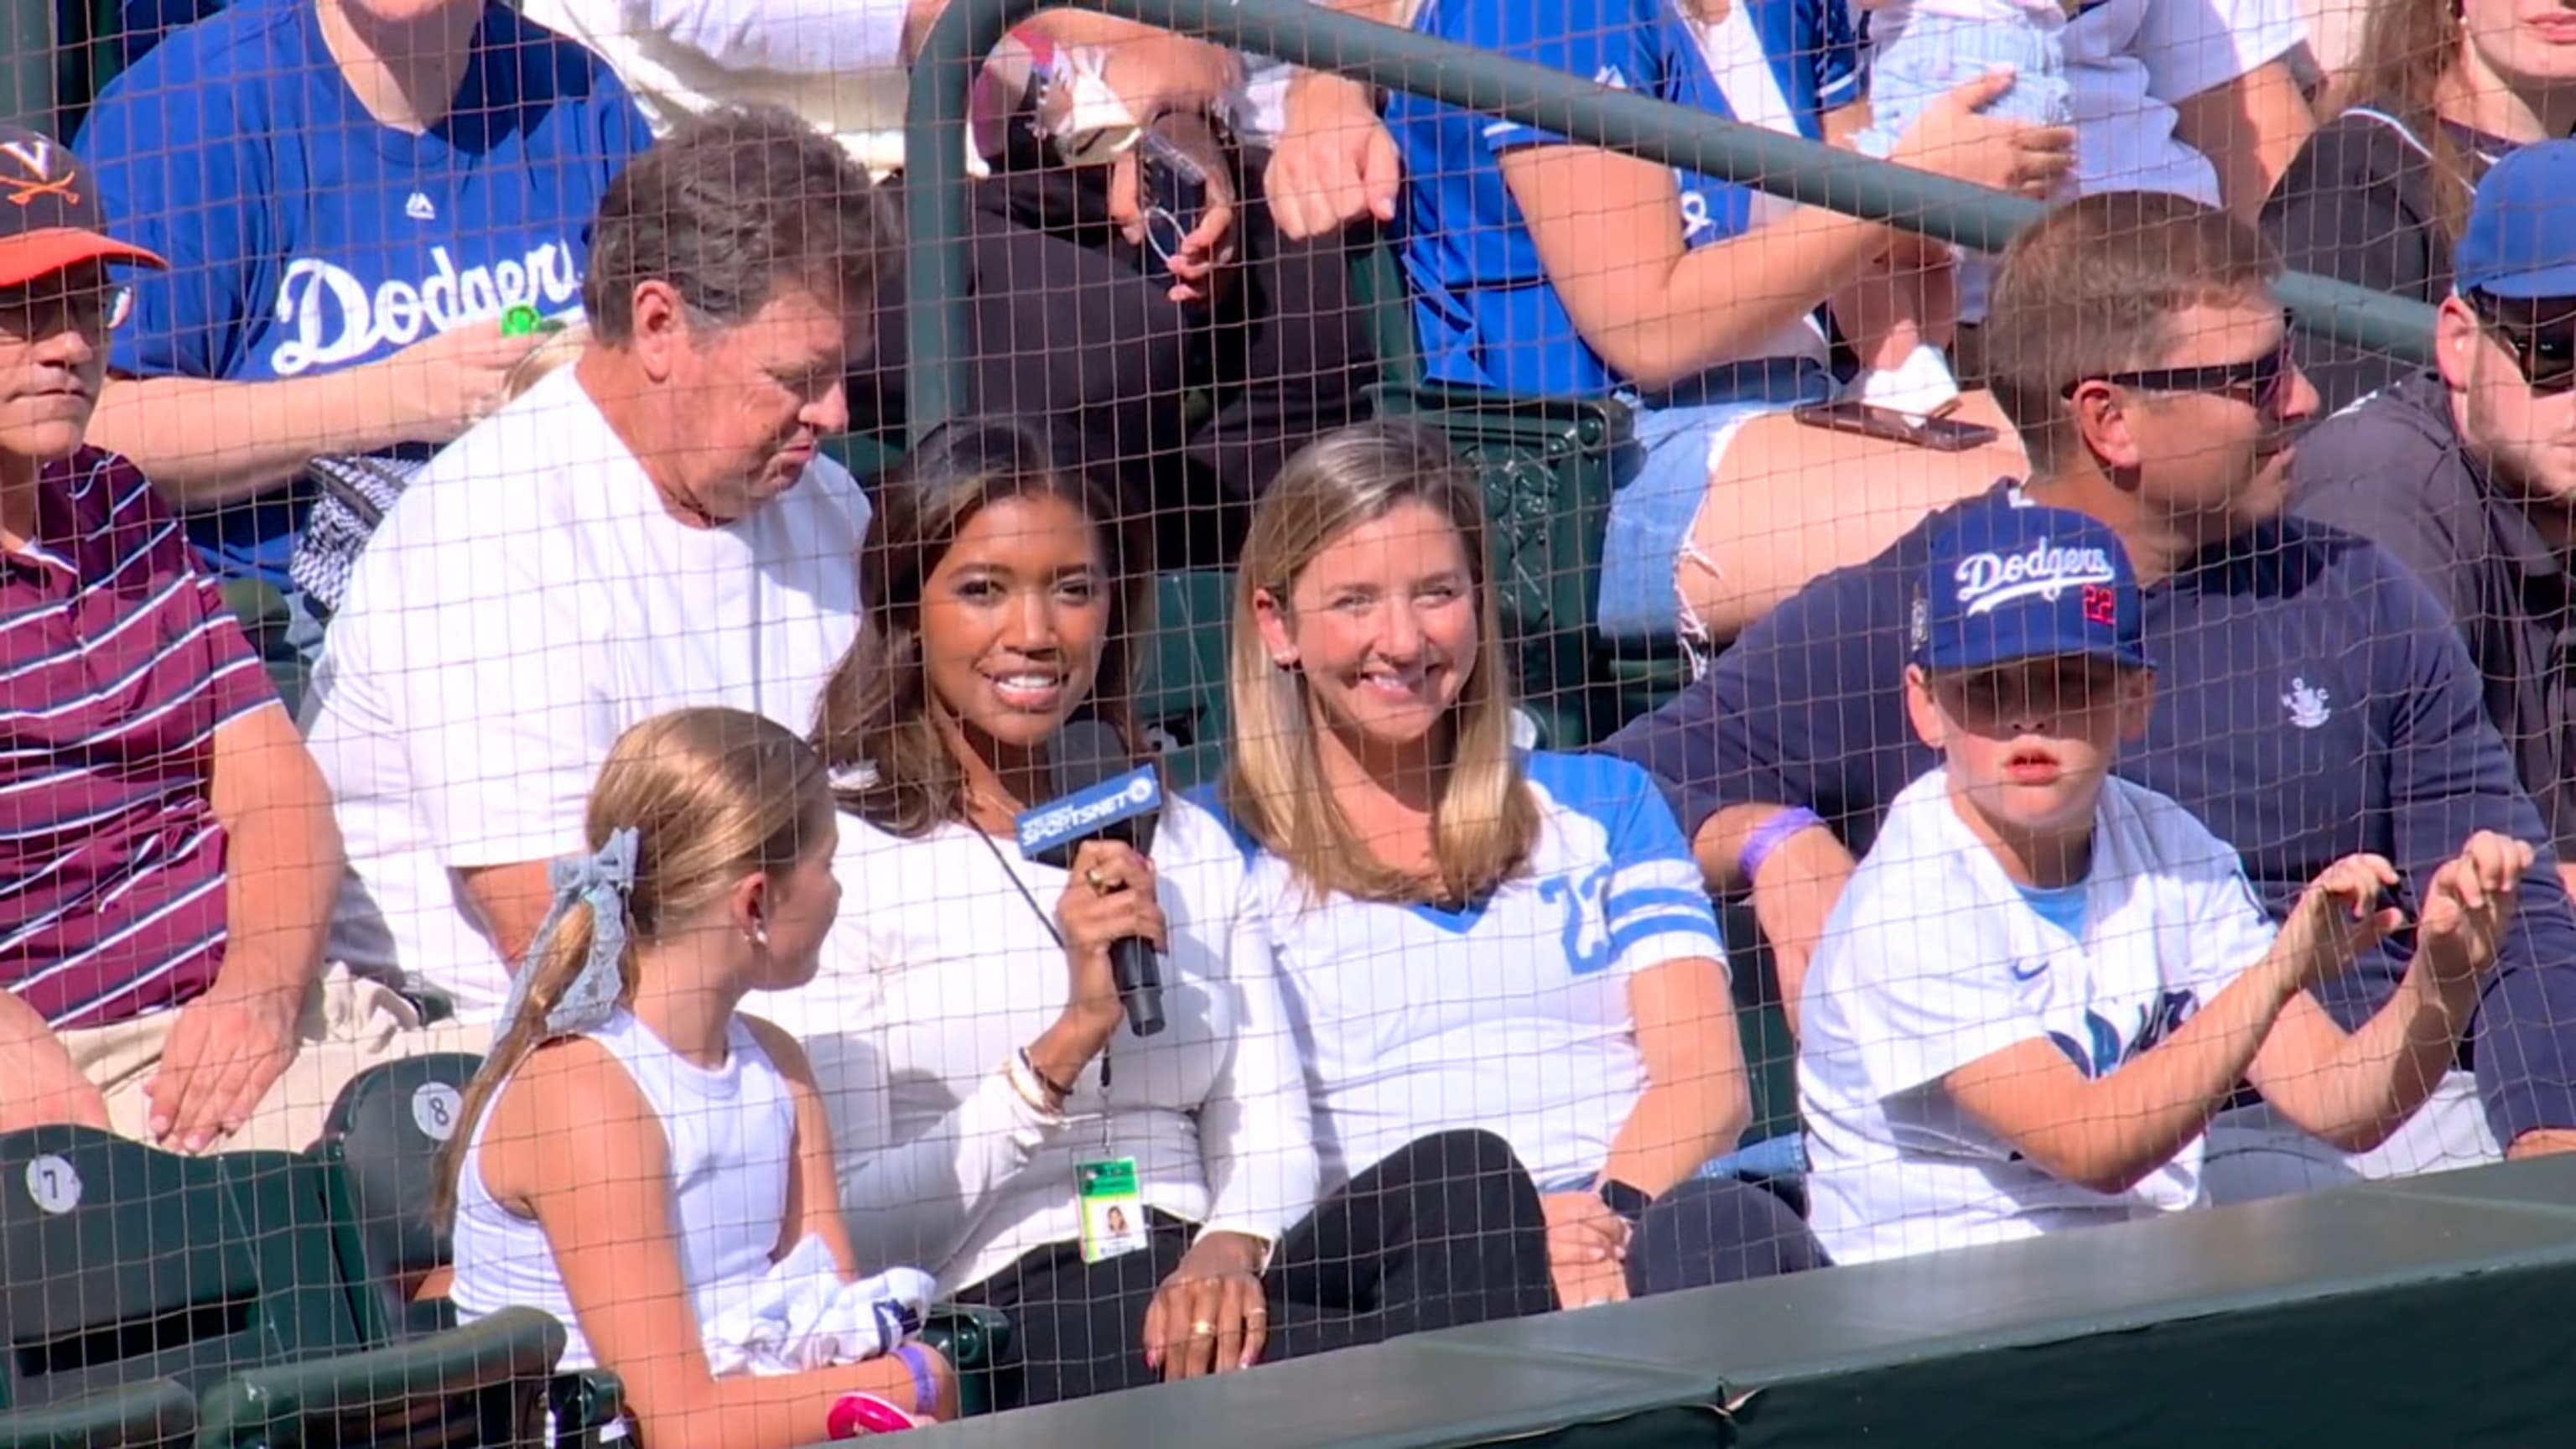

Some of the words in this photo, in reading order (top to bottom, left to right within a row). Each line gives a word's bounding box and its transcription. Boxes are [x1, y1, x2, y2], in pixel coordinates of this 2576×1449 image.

[0, 141, 49, 182] V
[1955, 536, 2115, 601] Dodgers
[2082, 584, 2116, 626] 22
[1021, 790, 1130, 846] SPORTSNET
[429, 1096, 450, 1126] 8
[42, 1169, 58, 1200] 7
